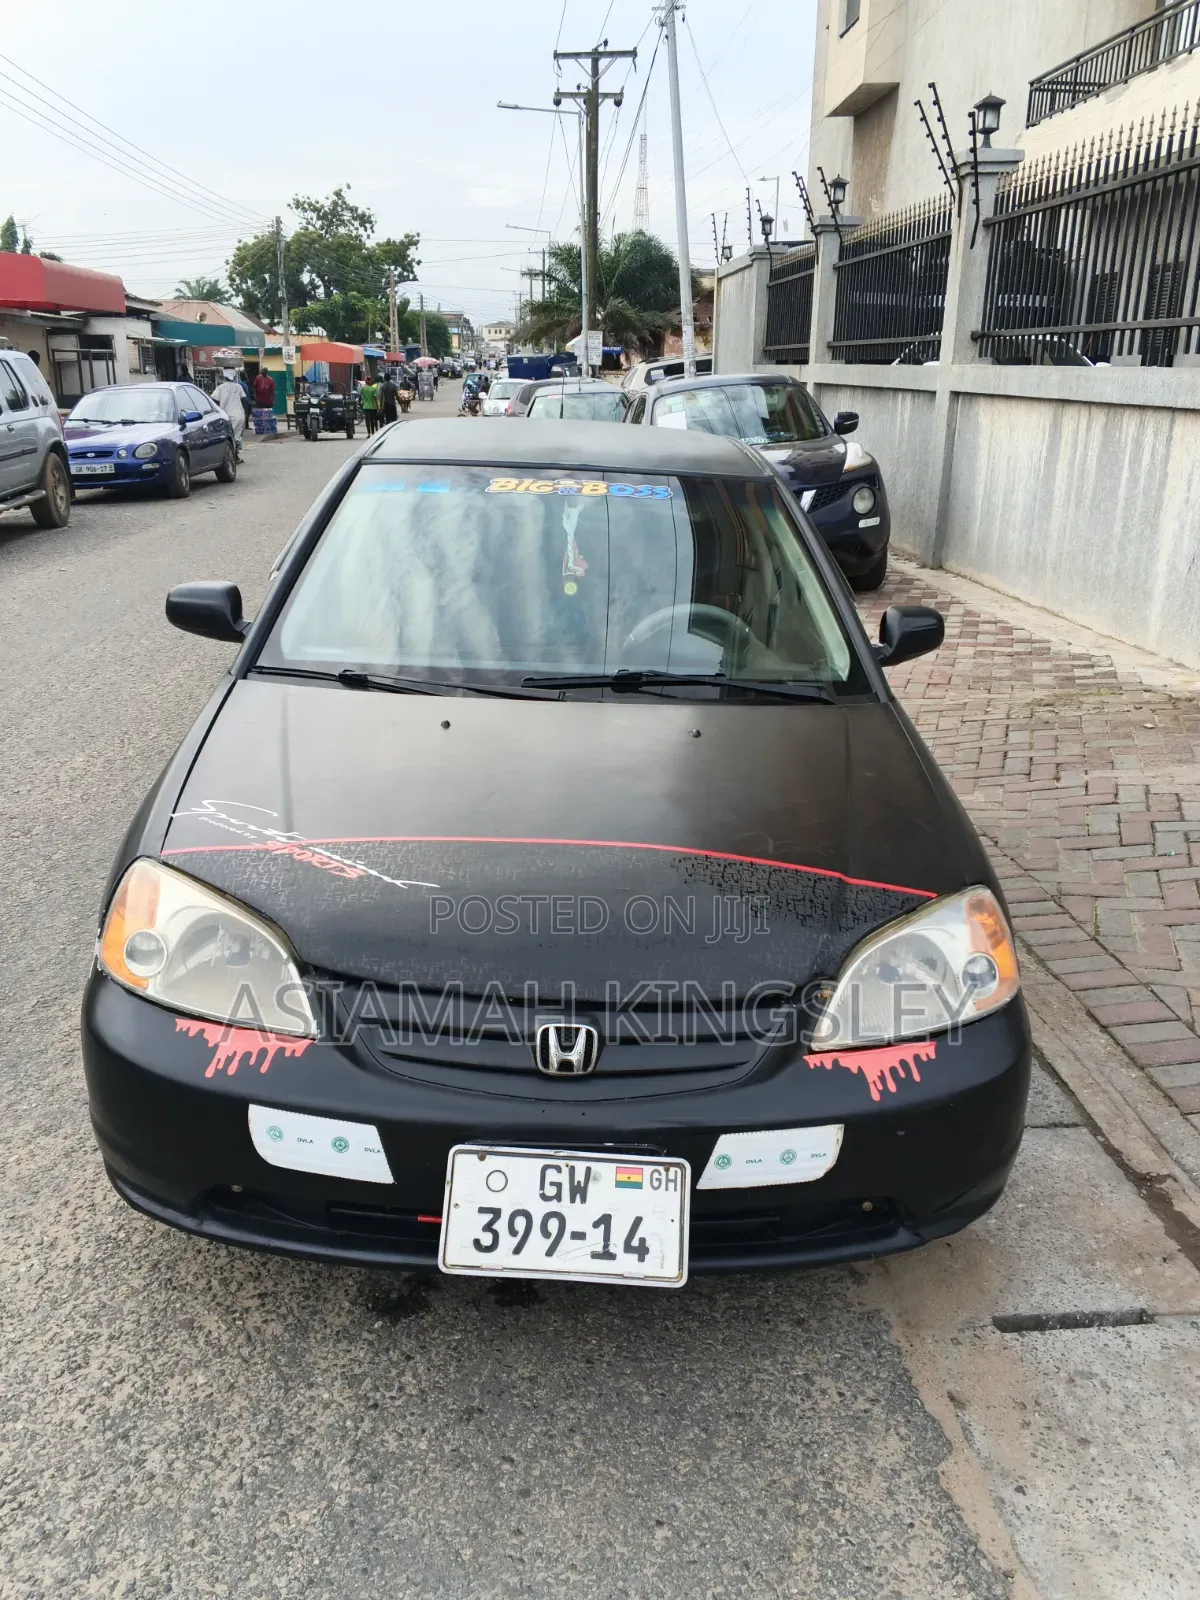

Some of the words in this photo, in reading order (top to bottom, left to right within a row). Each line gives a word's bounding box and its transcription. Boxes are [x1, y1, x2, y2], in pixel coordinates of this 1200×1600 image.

[485, 478, 554, 494] BIG
[580, 480, 674, 500] BOSS
[364, 1146, 382, 1154] DVLA
[538, 1163, 592, 1205] GW
[649, 1168, 679, 1193] GH
[472, 1206, 651, 1263] 399-14
